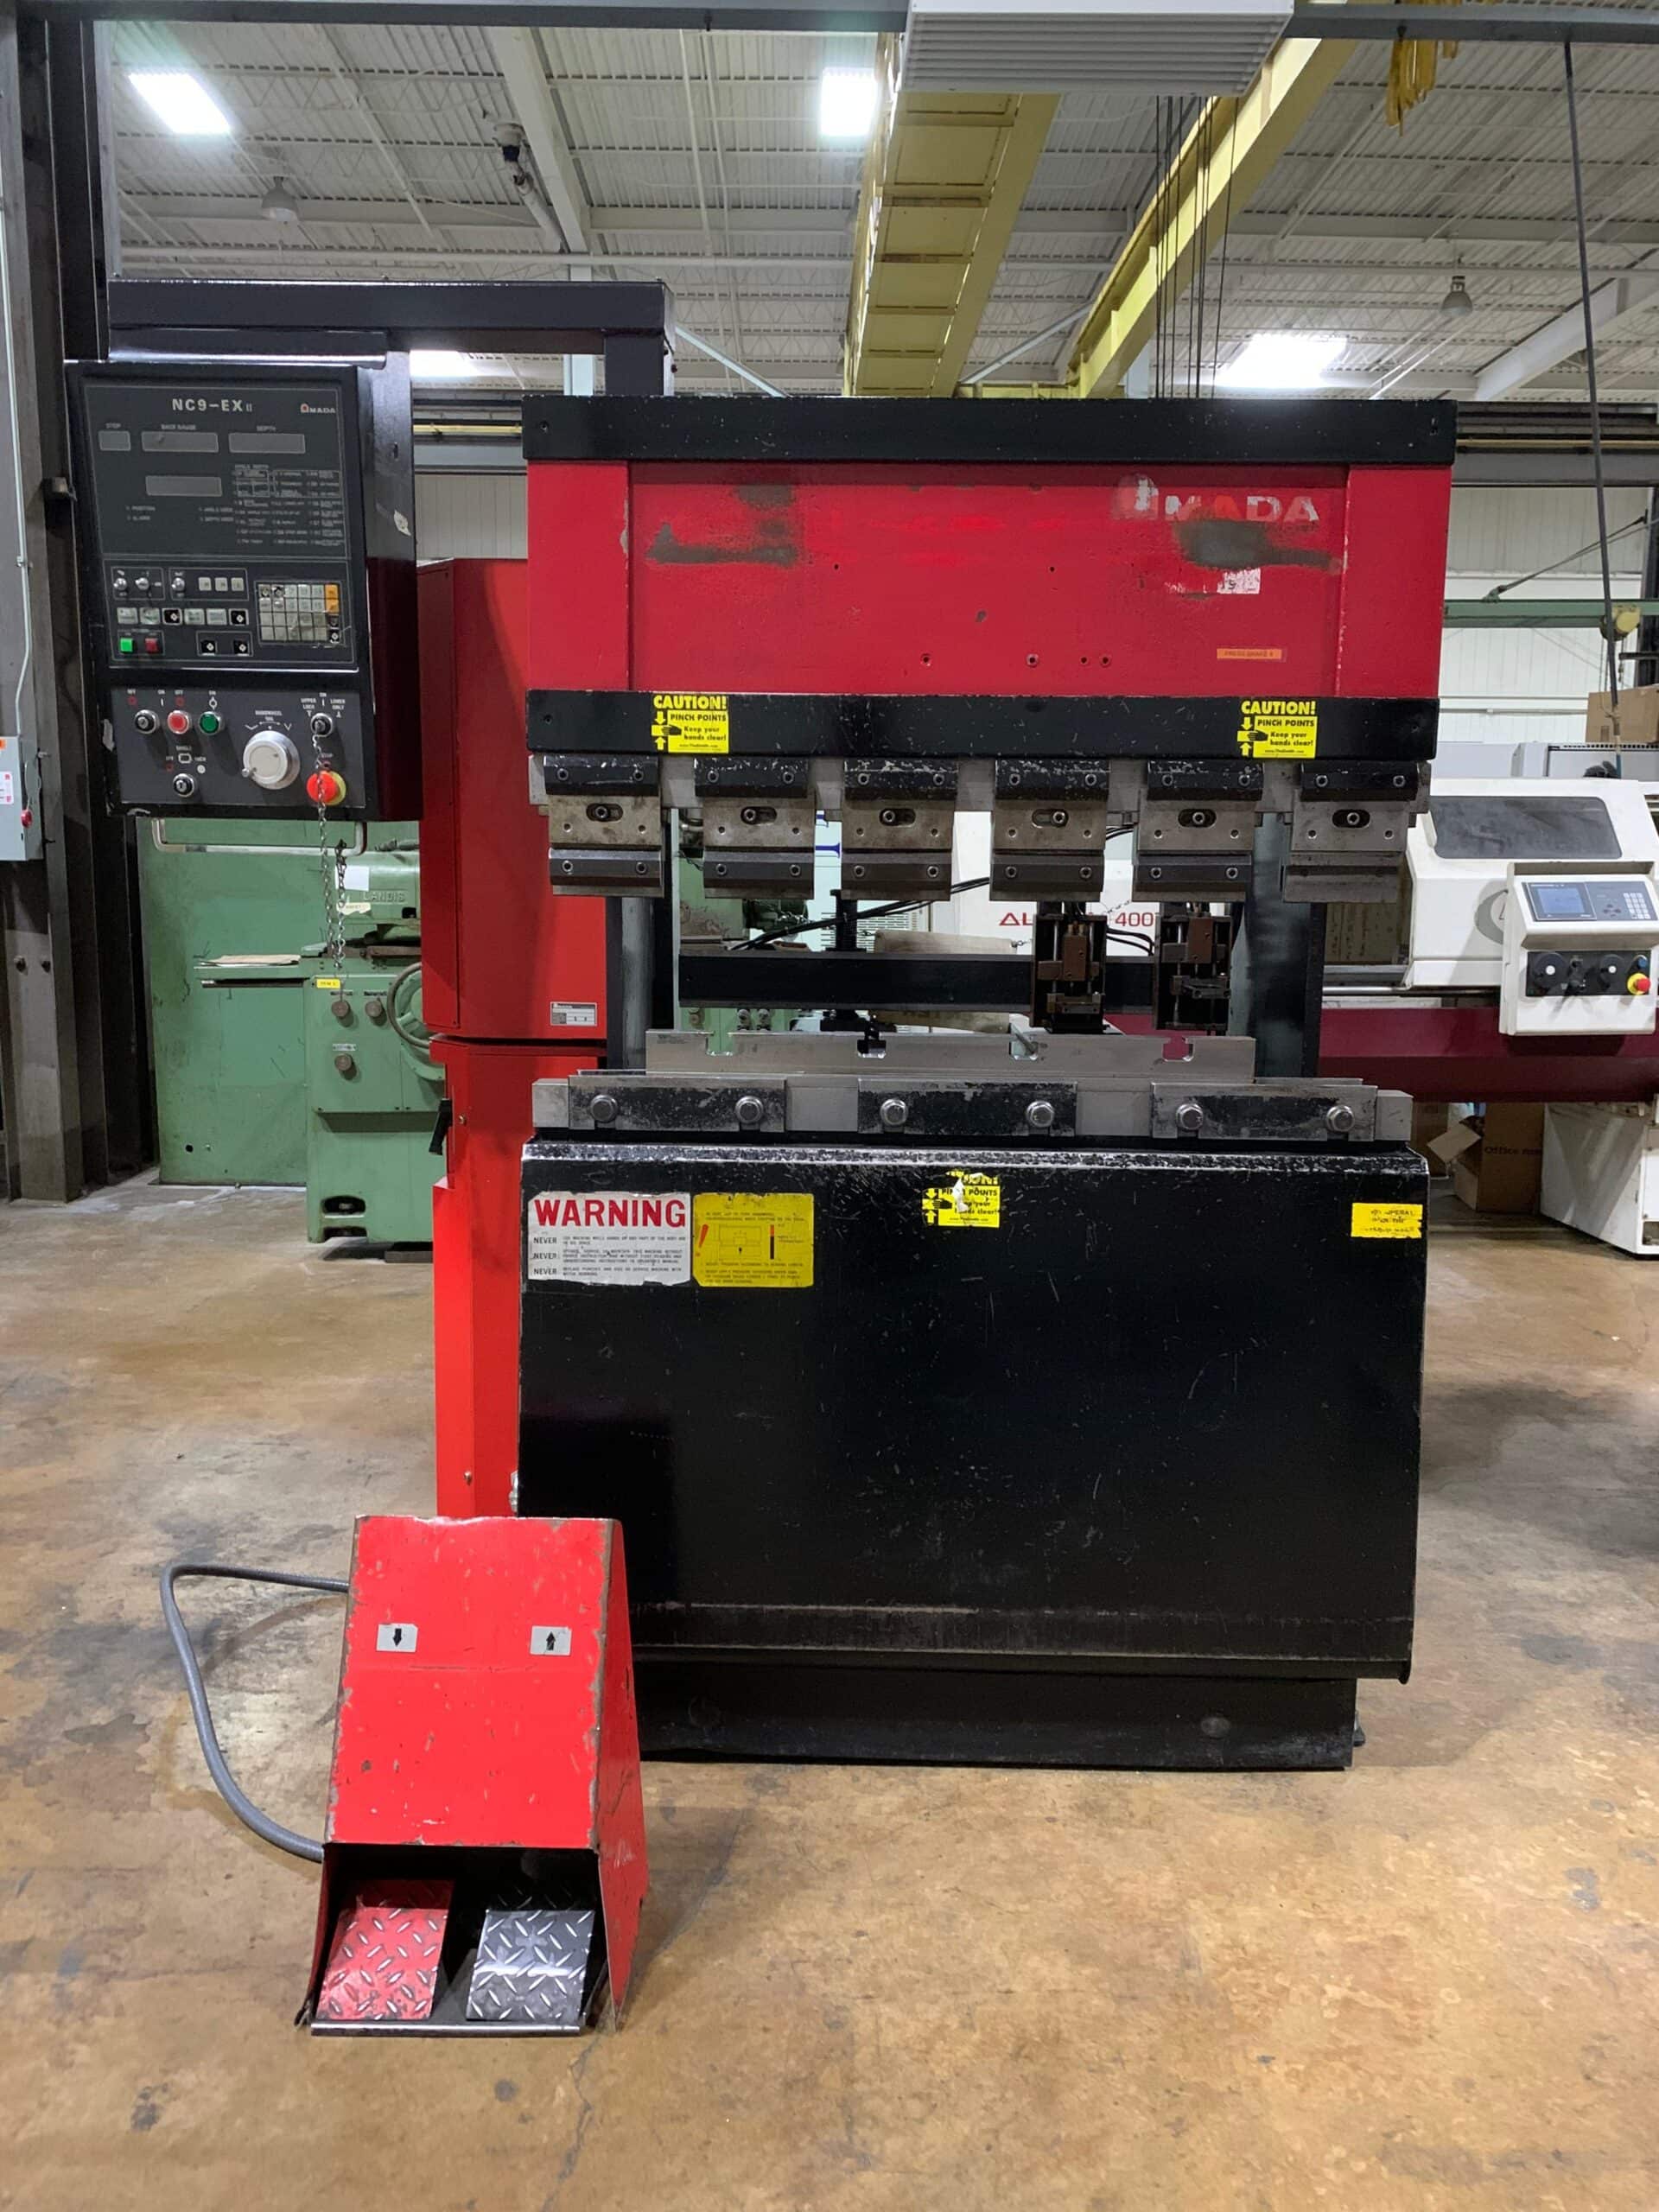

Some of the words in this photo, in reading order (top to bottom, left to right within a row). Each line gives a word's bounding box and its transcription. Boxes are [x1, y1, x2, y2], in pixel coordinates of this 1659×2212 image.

[172, 398, 243, 412] NC9-EX
[301, 403, 336, 414] AMADA
[653, 695, 727, 709] CAUTION!
[1241, 701, 1316, 715] CAUTION!
[363, 890, 406, 903] LANDIS
[533, 1198, 686, 1229] WARNING
[533, 1236, 556, 1245] NEVER
[533, 1252, 556, 1261] NEVER
